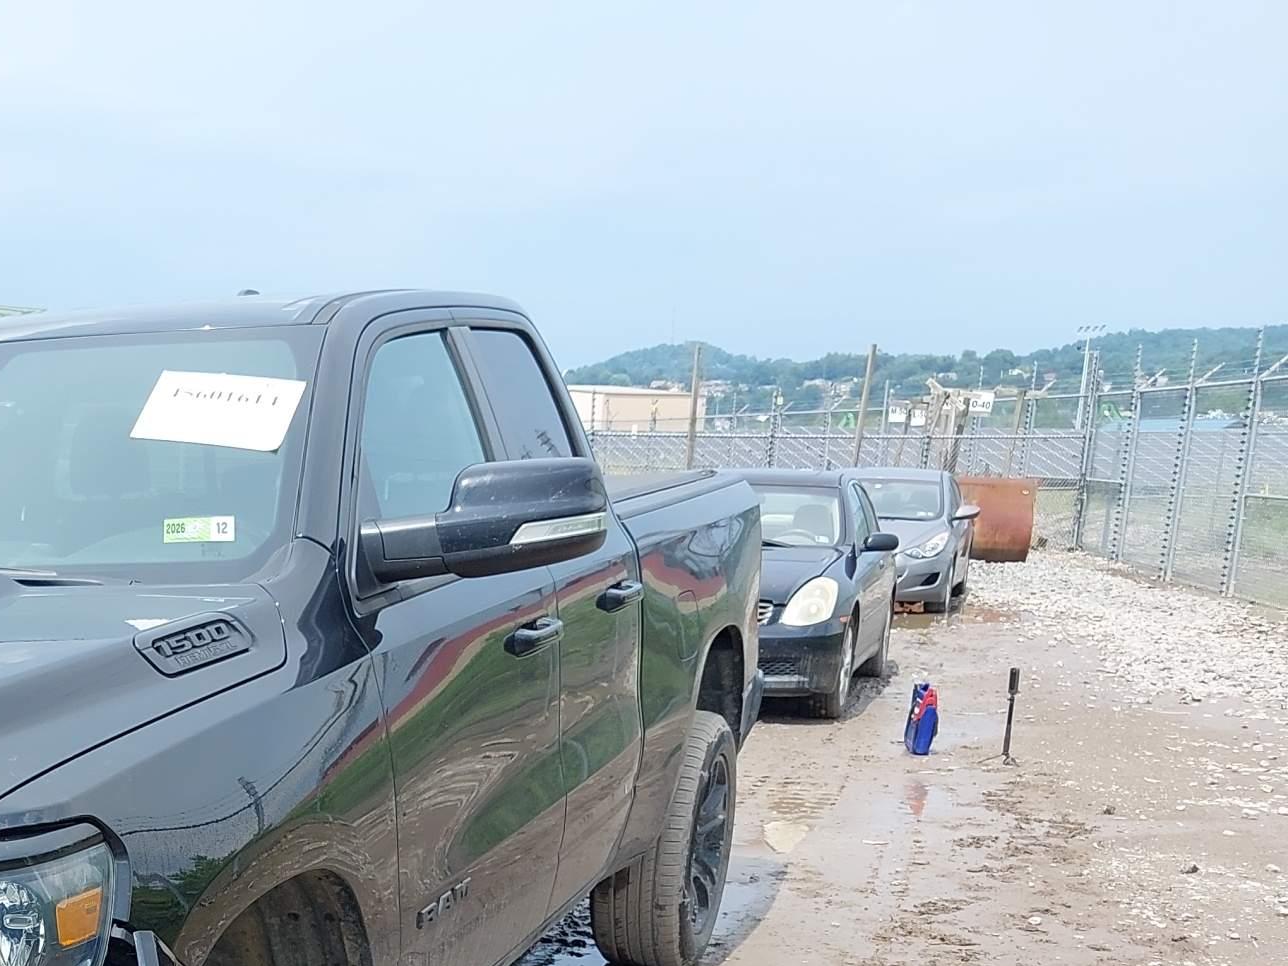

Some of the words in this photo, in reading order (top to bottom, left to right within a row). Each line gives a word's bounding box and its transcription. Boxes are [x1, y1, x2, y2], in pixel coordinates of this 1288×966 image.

[166, 522, 186, 535] 2026
[216, 521, 228, 534] 12
[152, 621, 231, 658] 1500
[416, 876, 472, 930] RAM
